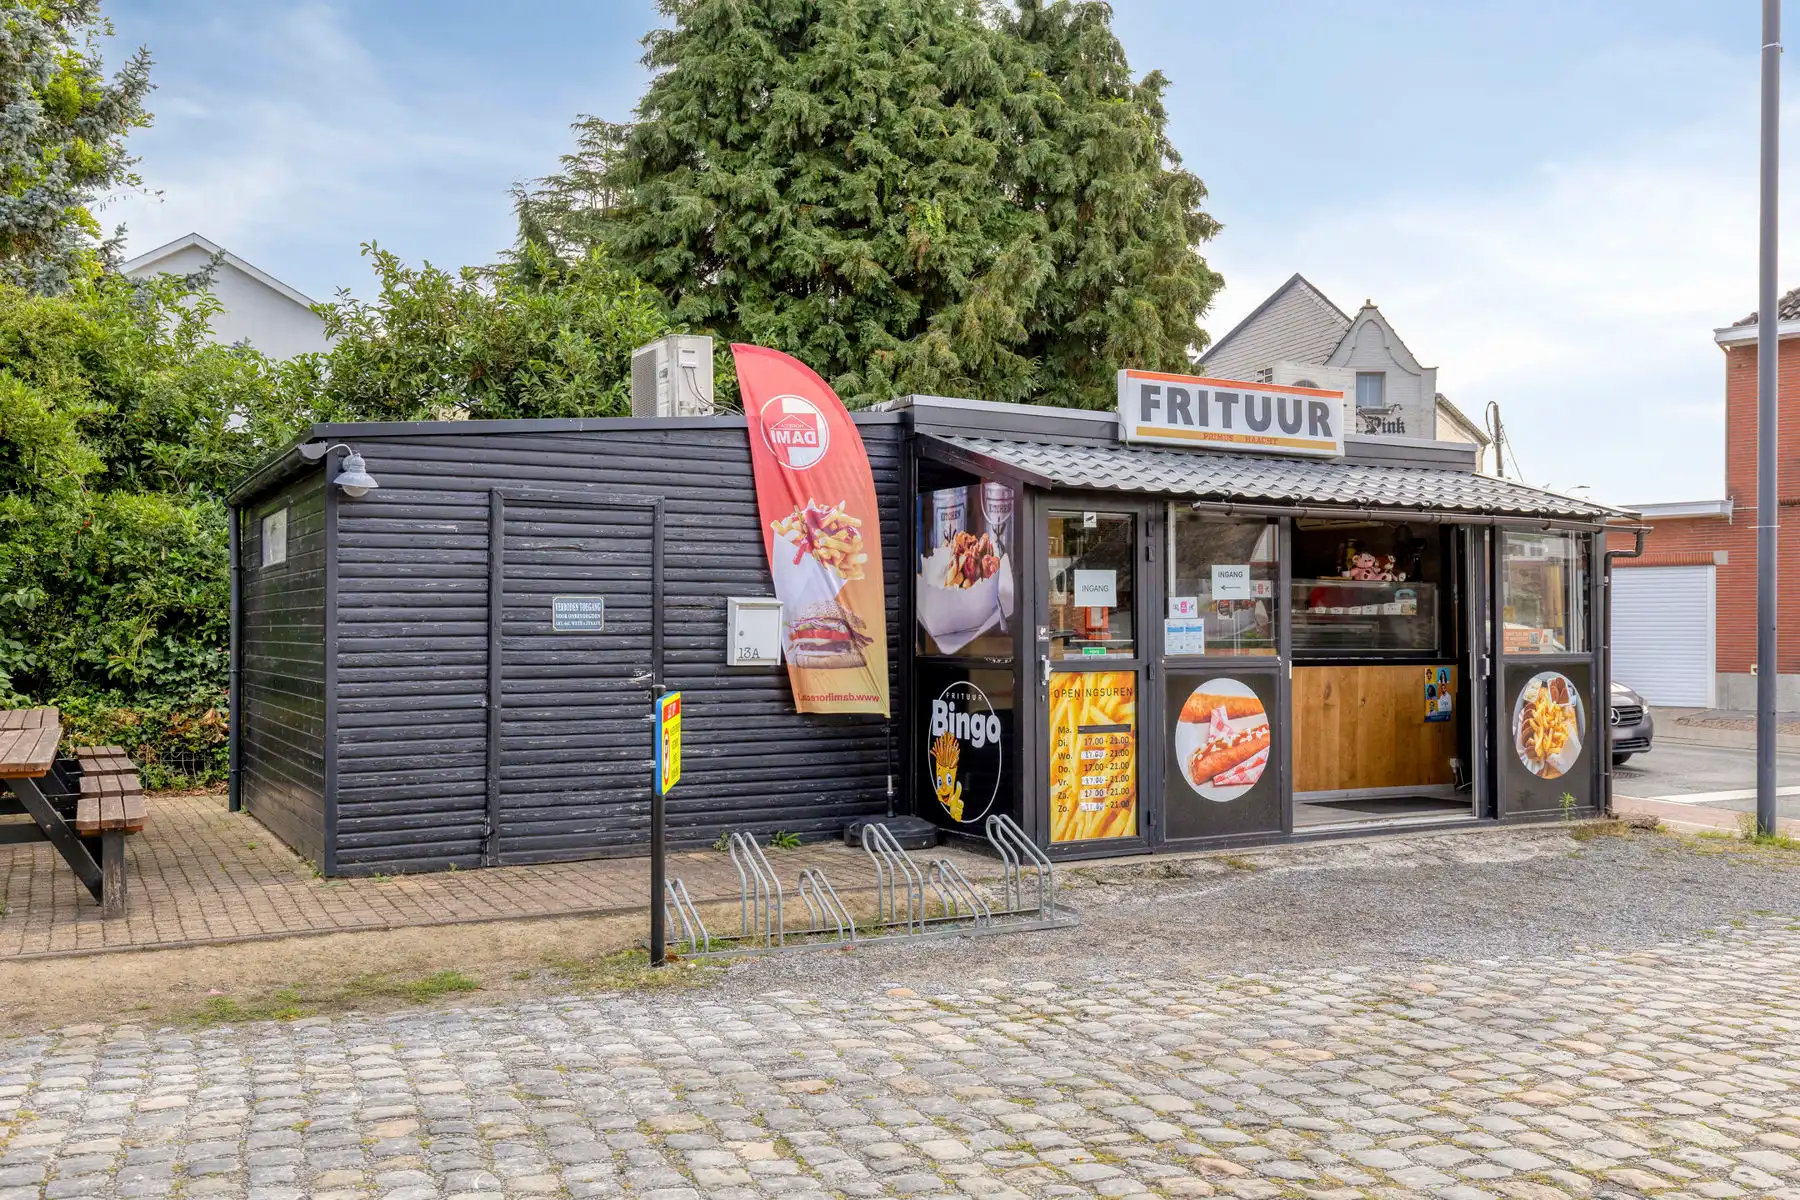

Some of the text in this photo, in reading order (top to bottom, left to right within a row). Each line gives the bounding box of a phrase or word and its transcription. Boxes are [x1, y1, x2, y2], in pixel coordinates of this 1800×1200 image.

[1140, 383, 1333, 438] FRITUUR
[1364, 415, 1406, 435] Pink
[1203, 432, 1278, 445] PRIMUS HAACHT
[1081, 584, 1109, 593] INGANG
[738, 646, 761, 659] 13A
[946, 692, 983, 701] FRITUUR
[1053, 687, 1133, 699] OPENINGSUREN
[932, 699, 1002, 748] Bingo
[1057, 726, 1072, 734] Ma.
[1057, 739, 1068, 747] Di.
[1084, 737, 1104, 746] 17.00
[1109, 736, 1130, 745] 21.00
[1057, 752, 1073, 760] Wo.
[1109, 748, 1130, 758] 21.00
[1057, 765, 1071, 774] Do.
[1084, 762, 1104, 772] 17.00
[1110, 761, 1130, 771] 21.00
[1057, 778, 1069, 787] Vr.
[1110, 774, 1130, 783] 21.00
[1057, 791, 1069, 800] Za.
[1110, 787, 1130, 796] 21.00
[1057, 804, 1070, 813] Zo.
[1110, 799, 1130, 809] 21.00
